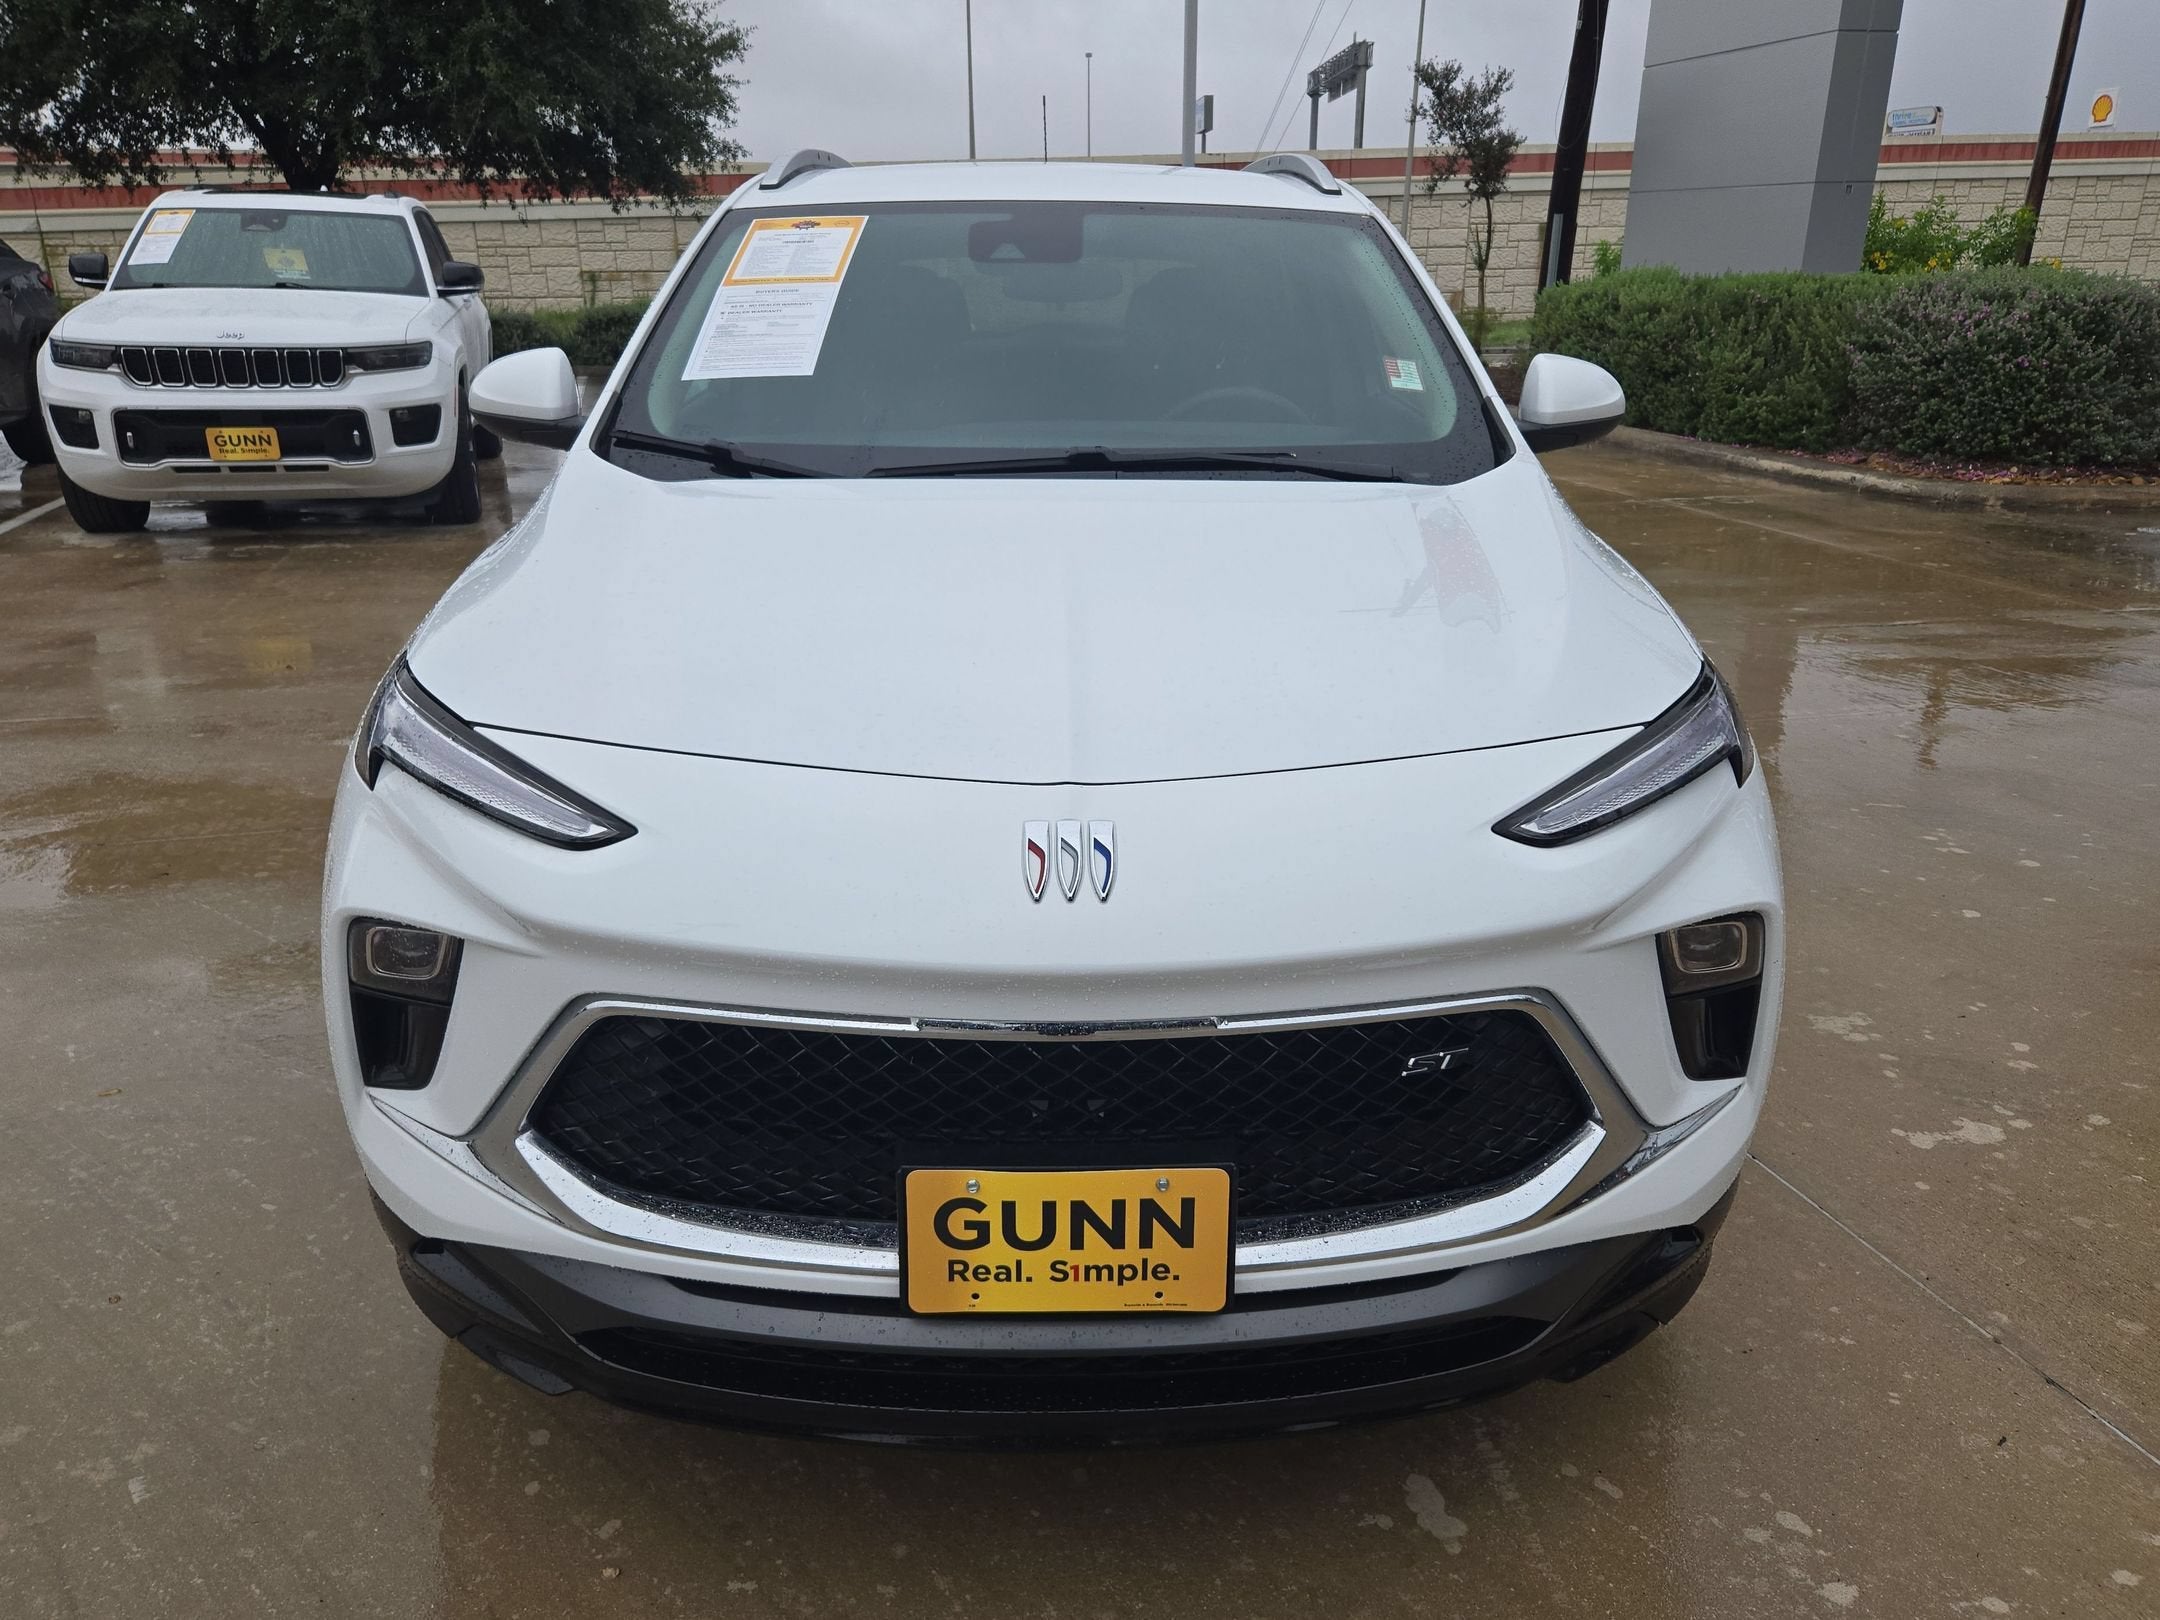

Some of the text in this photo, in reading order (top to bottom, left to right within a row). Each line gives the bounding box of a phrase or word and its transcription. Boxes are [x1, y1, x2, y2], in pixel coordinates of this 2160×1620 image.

[216, 330, 246, 340] Jeep
[214, 434, 273, 447] GUNN
[932, 1196, 1196, 1252] GUNN
[947, 1258, 1034, 1283] Real.
